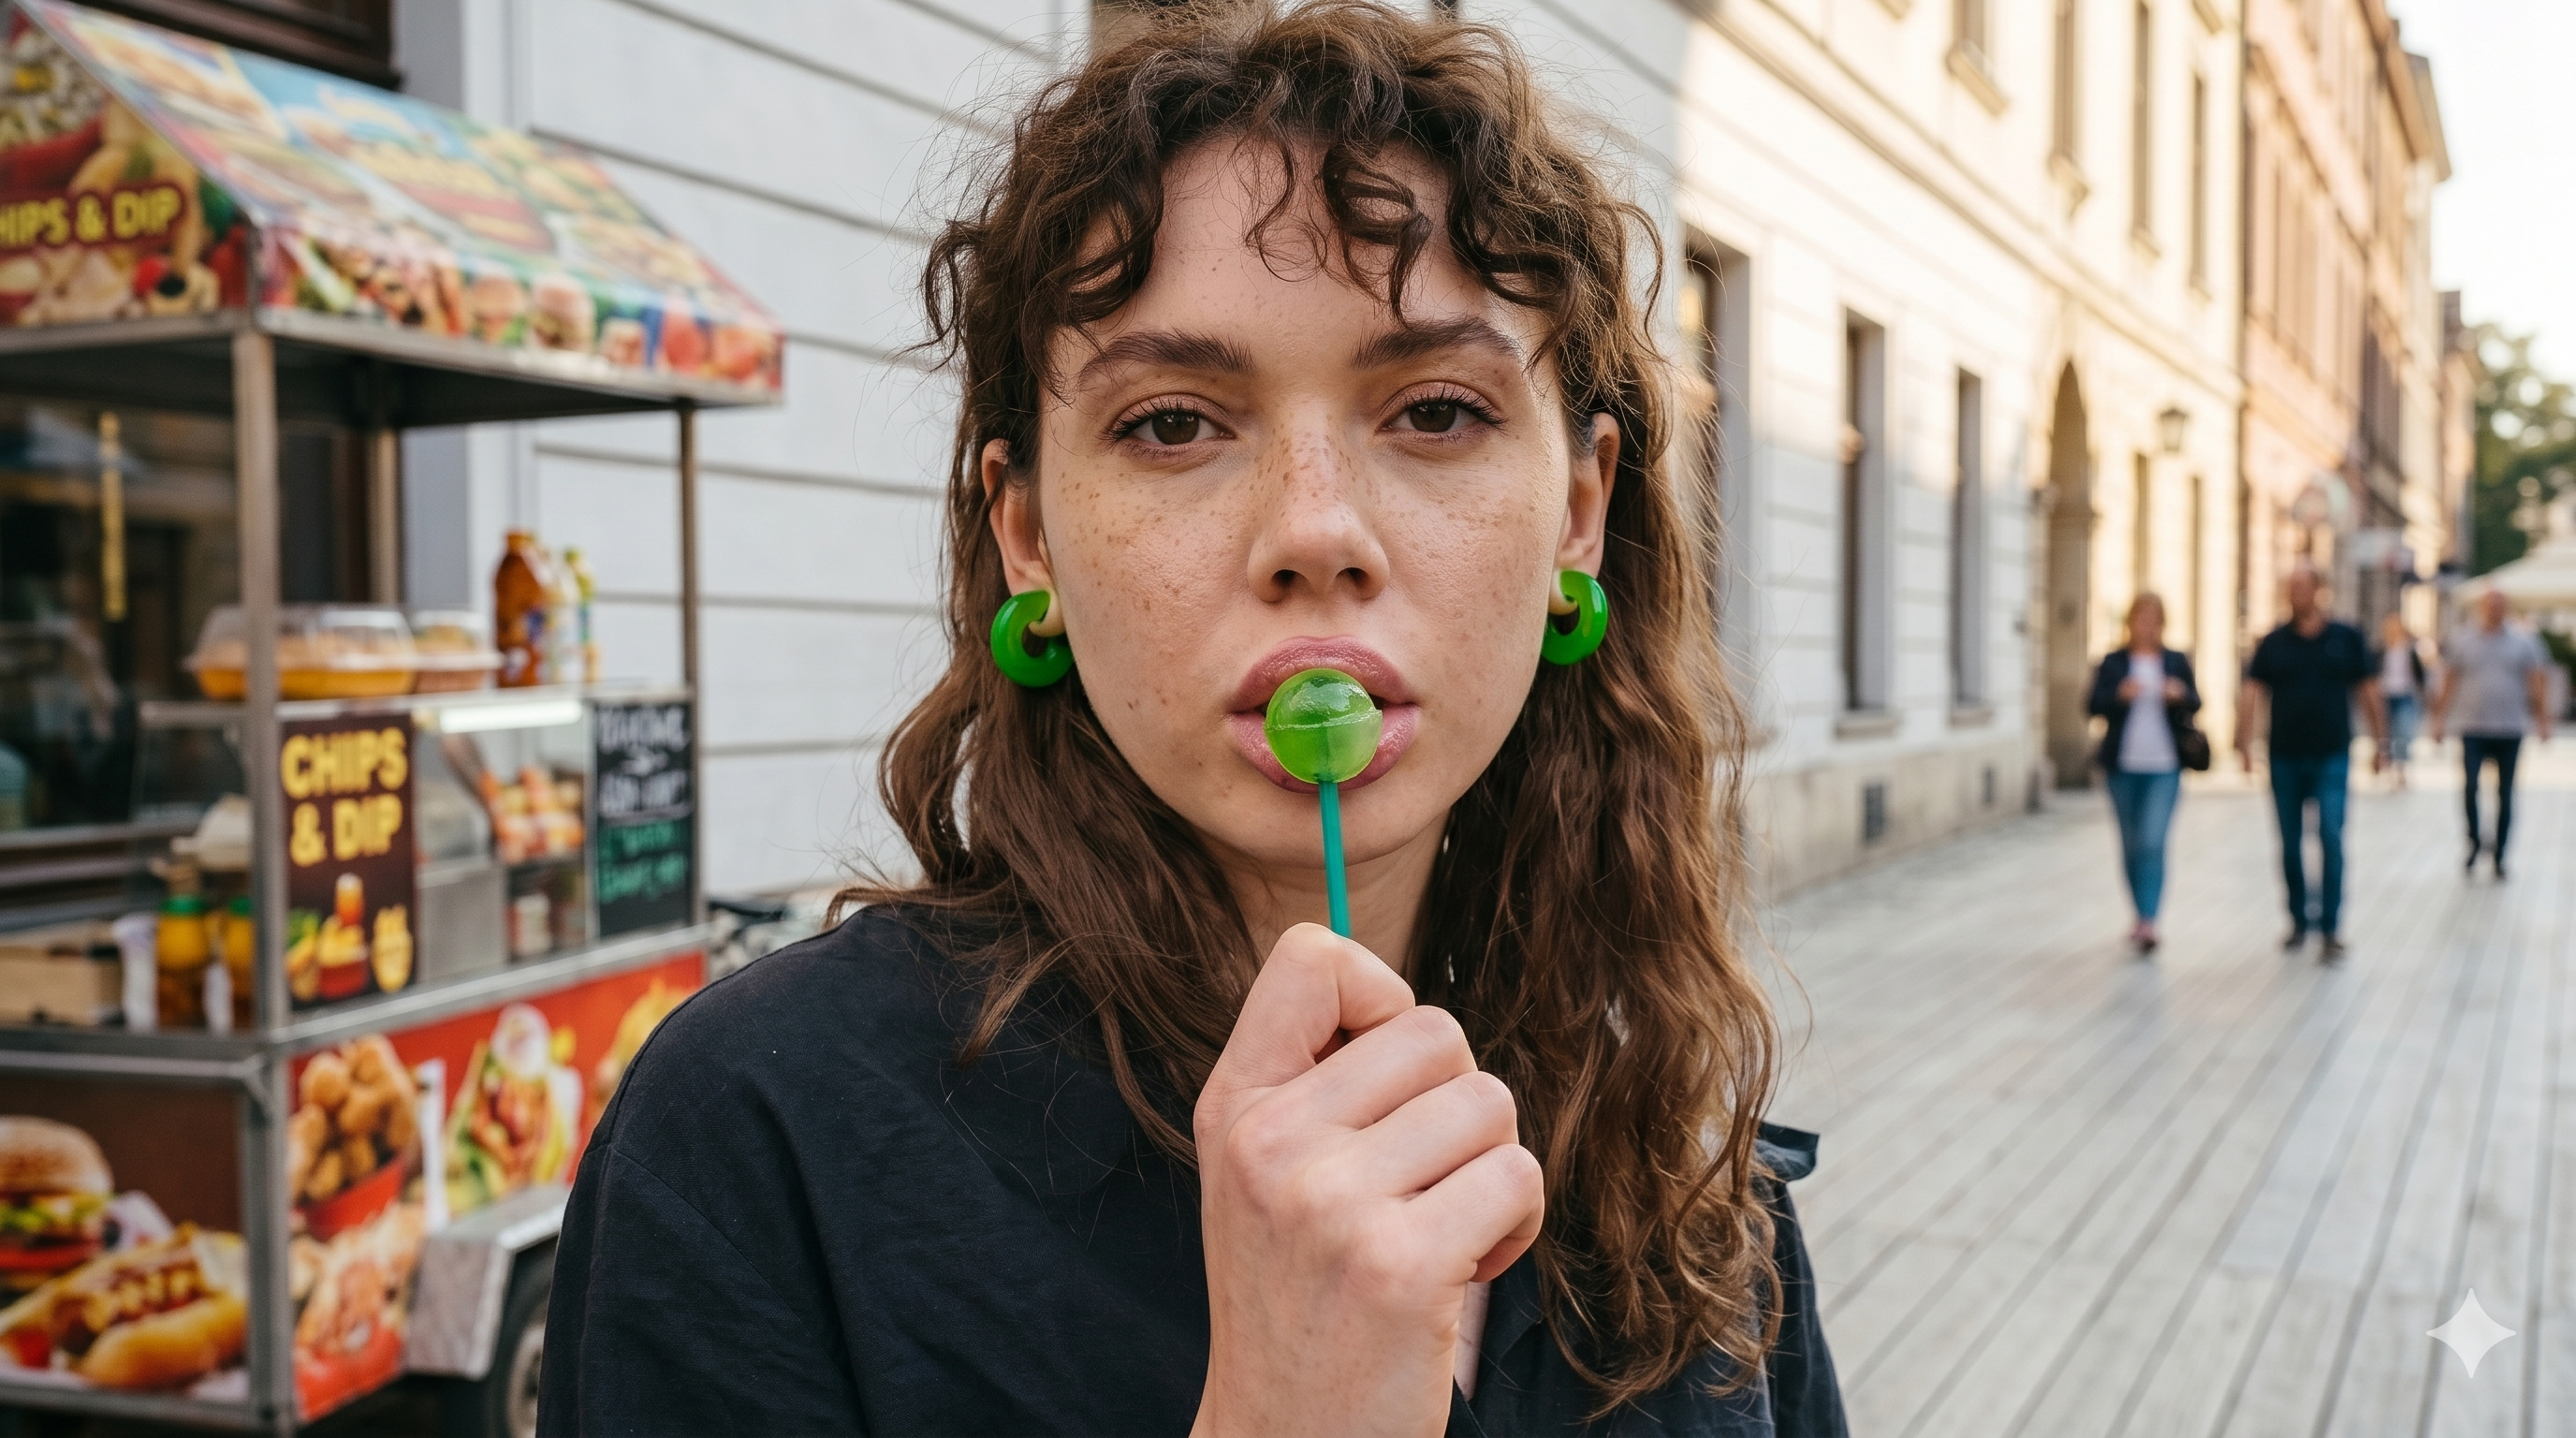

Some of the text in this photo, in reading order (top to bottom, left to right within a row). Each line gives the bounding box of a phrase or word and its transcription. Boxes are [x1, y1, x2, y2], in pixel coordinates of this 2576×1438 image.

[77, 195, 106, 242] &
[113, 187, 181, 238] DIP
[282, 727, 408, 799] CHIPS
[290, 794, 402, 866] & DIP
